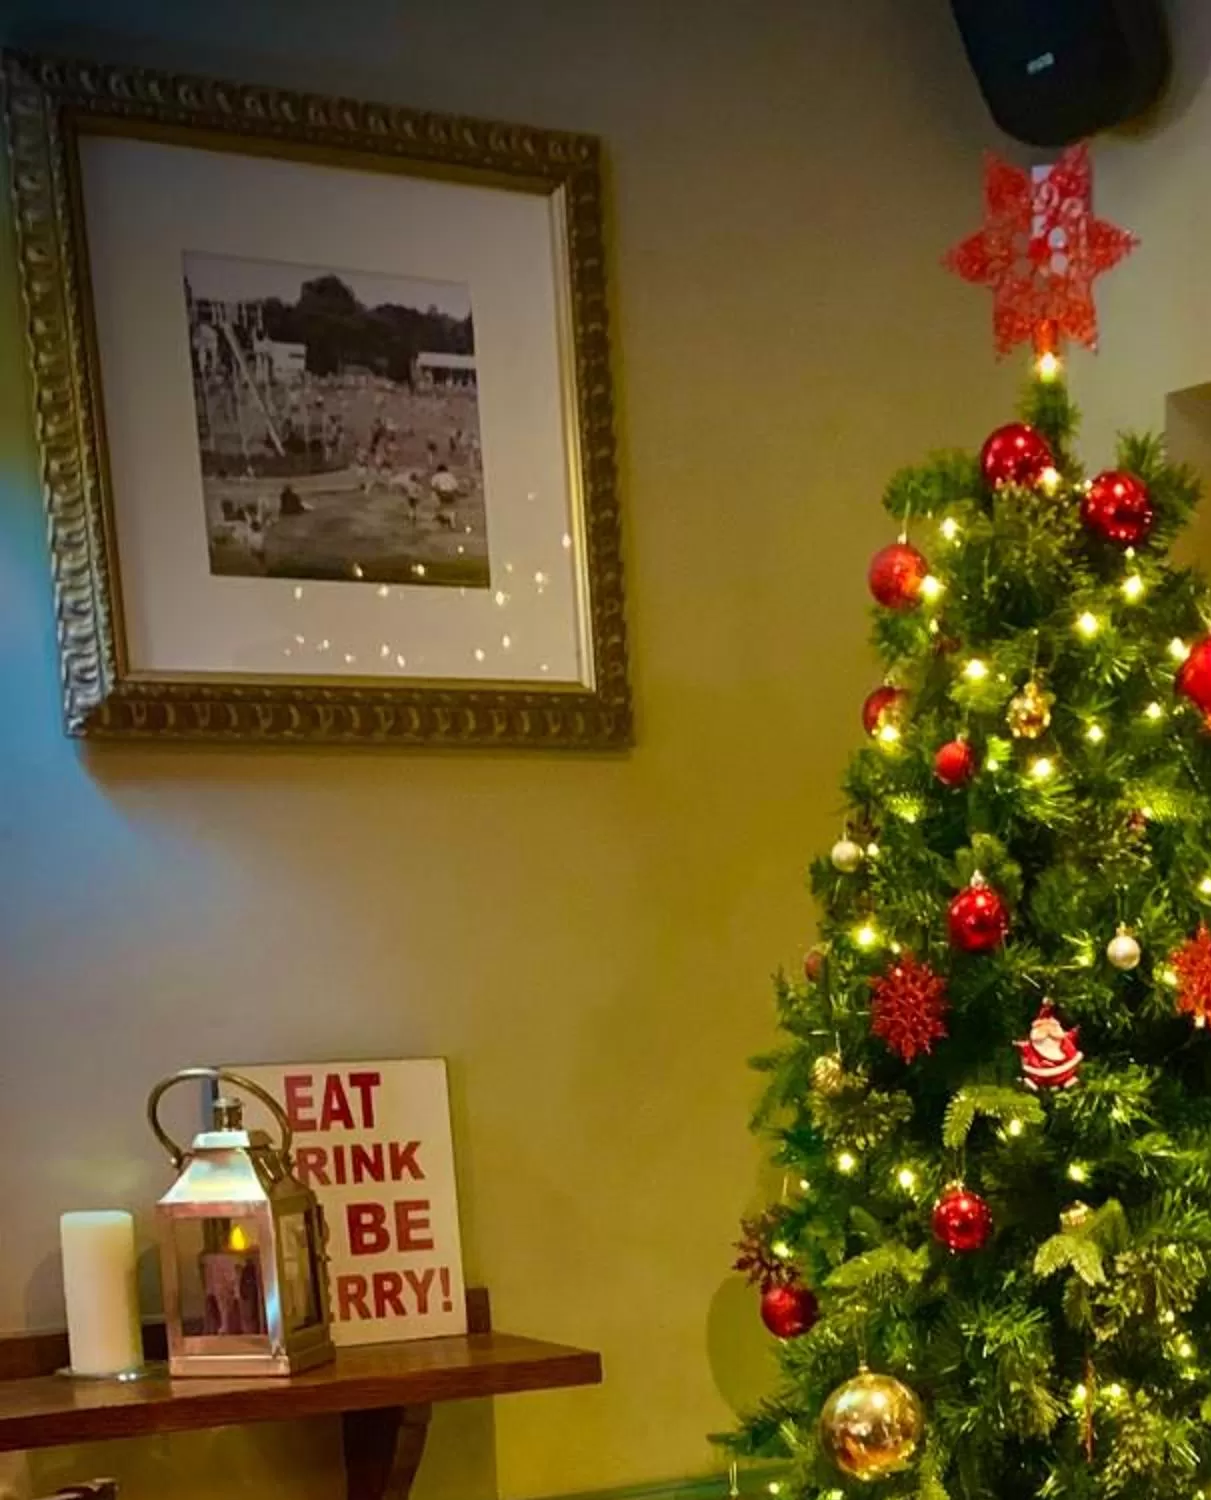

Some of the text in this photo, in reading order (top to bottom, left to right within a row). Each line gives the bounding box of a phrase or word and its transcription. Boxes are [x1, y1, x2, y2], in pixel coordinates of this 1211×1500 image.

[284, 1072, 381, 1132] EAT
[295, 1141, 425, 1187] RINK
[346, 1200, 434, 1255] BE
[336, 1266, 453, 1321] RRY!
